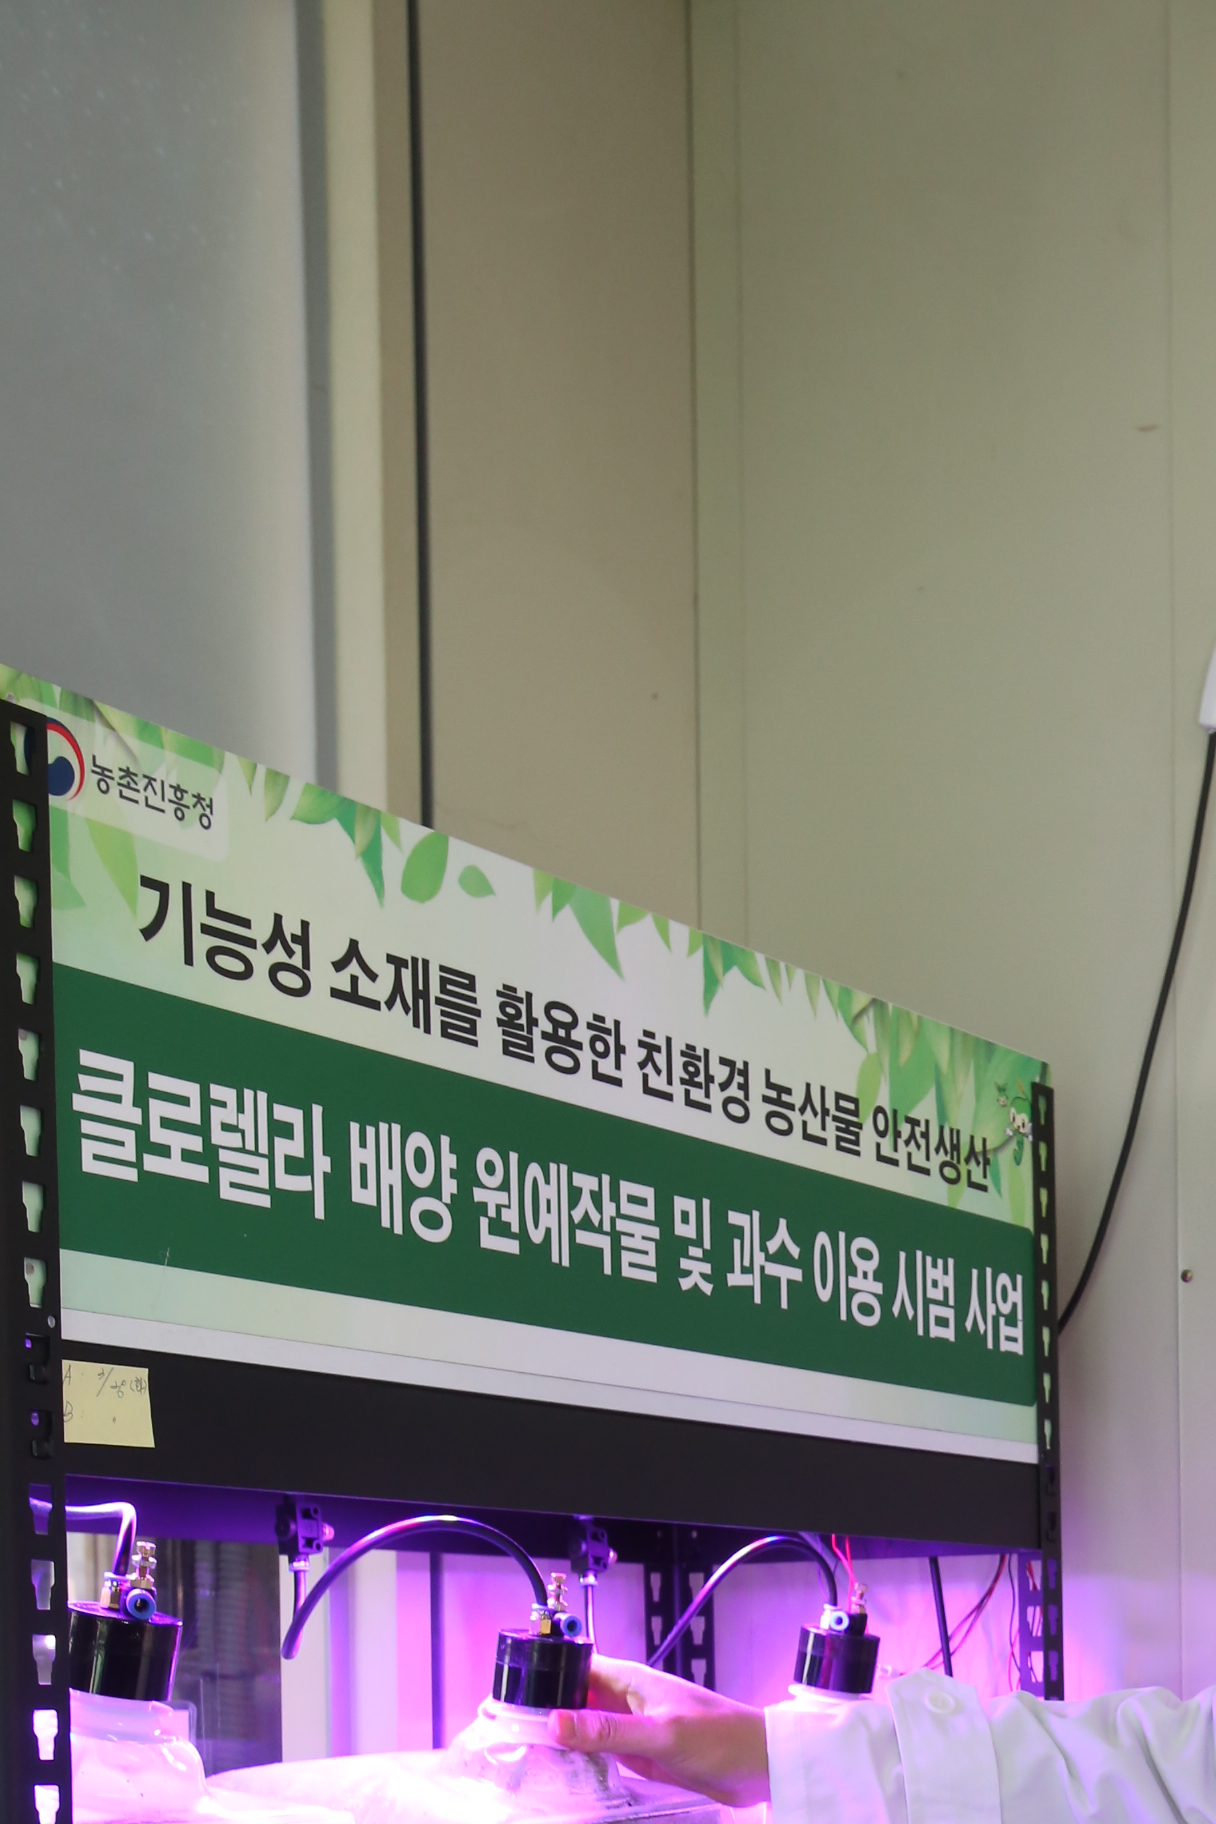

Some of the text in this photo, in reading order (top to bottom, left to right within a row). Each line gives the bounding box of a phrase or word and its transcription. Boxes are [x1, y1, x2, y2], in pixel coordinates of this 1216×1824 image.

[89, 753, 216, 831] 농촌진흥청
[138, 873, 992, 1194] 기능성 소재를 활용한 친환경 농산물 안전생산
[72, 1048, 1026, 1357] 클로렐라 배양 원예작물 및 과수 이용 시범 사업
